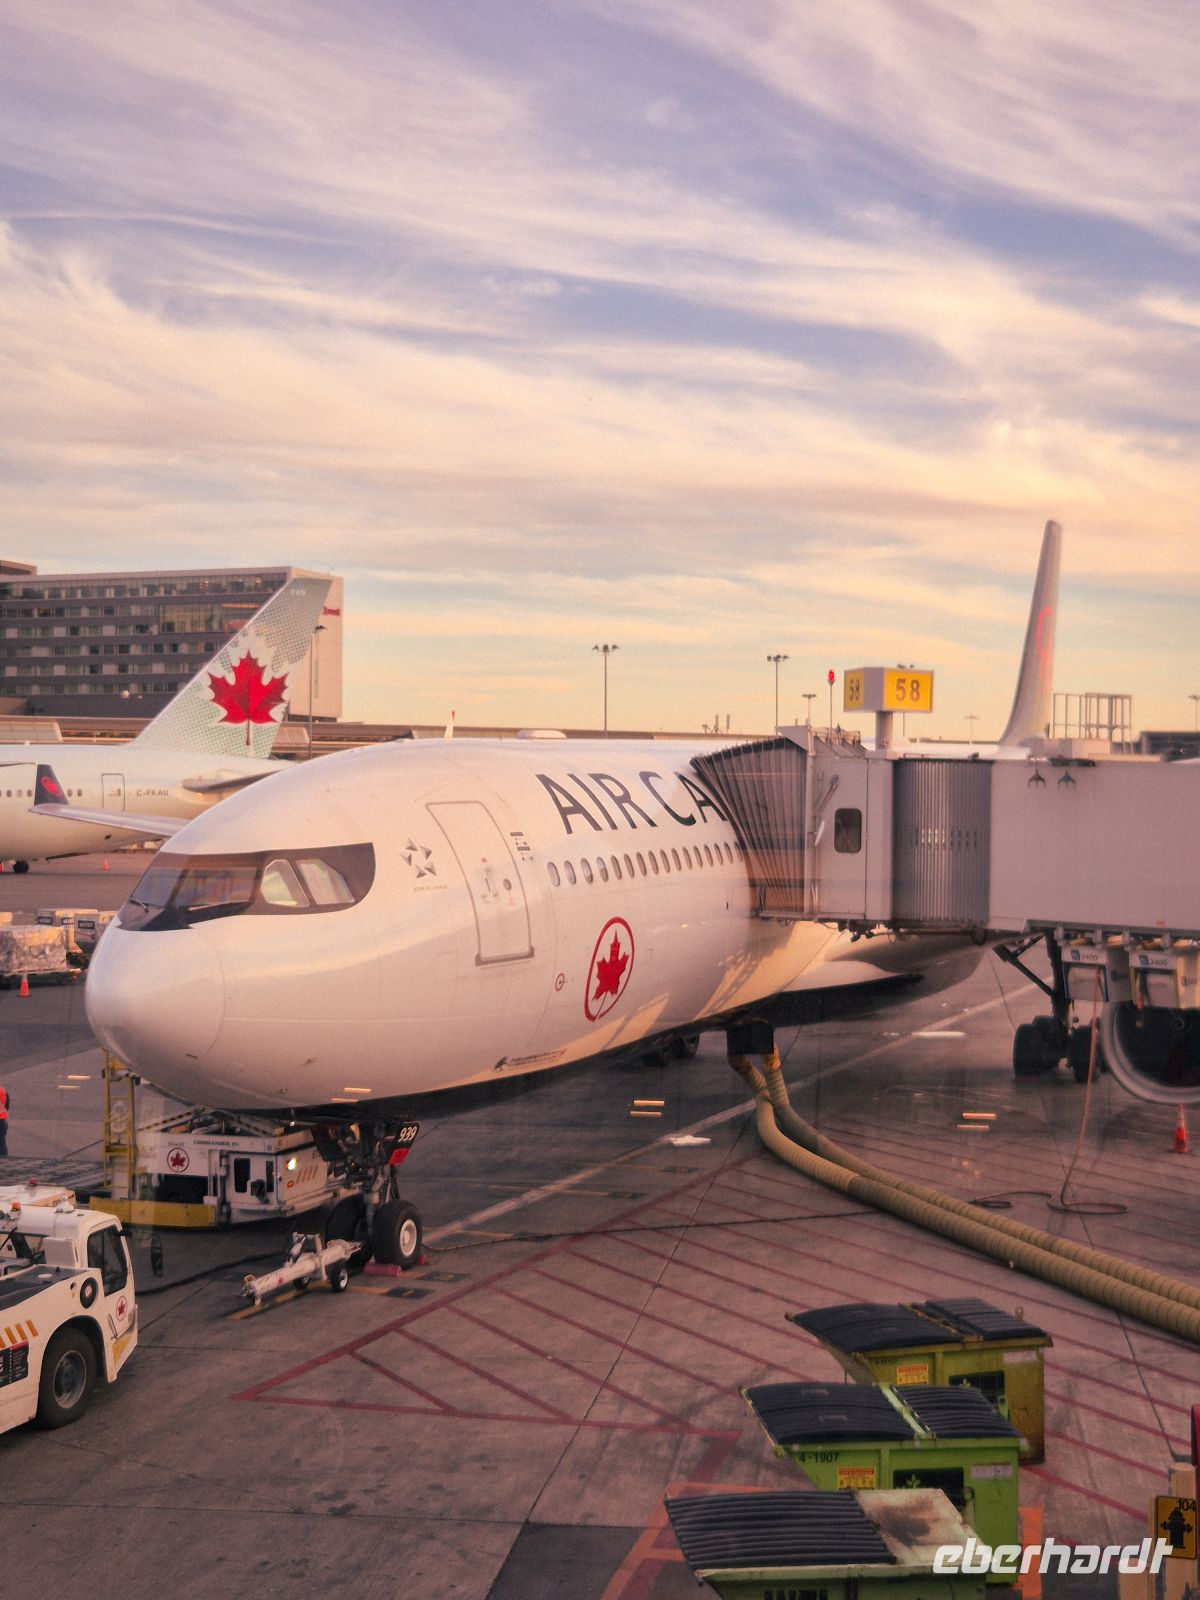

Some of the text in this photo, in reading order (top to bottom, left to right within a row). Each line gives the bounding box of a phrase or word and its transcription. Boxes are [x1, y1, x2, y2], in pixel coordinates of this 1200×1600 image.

[849, 679, 860, 701] 58
[896, 678, 921, 702] 58
[535, 773, 658, 835] AIR
[397, 1125, 418, 1142] 939
[1176, 1498, 1197, 1513] 104
